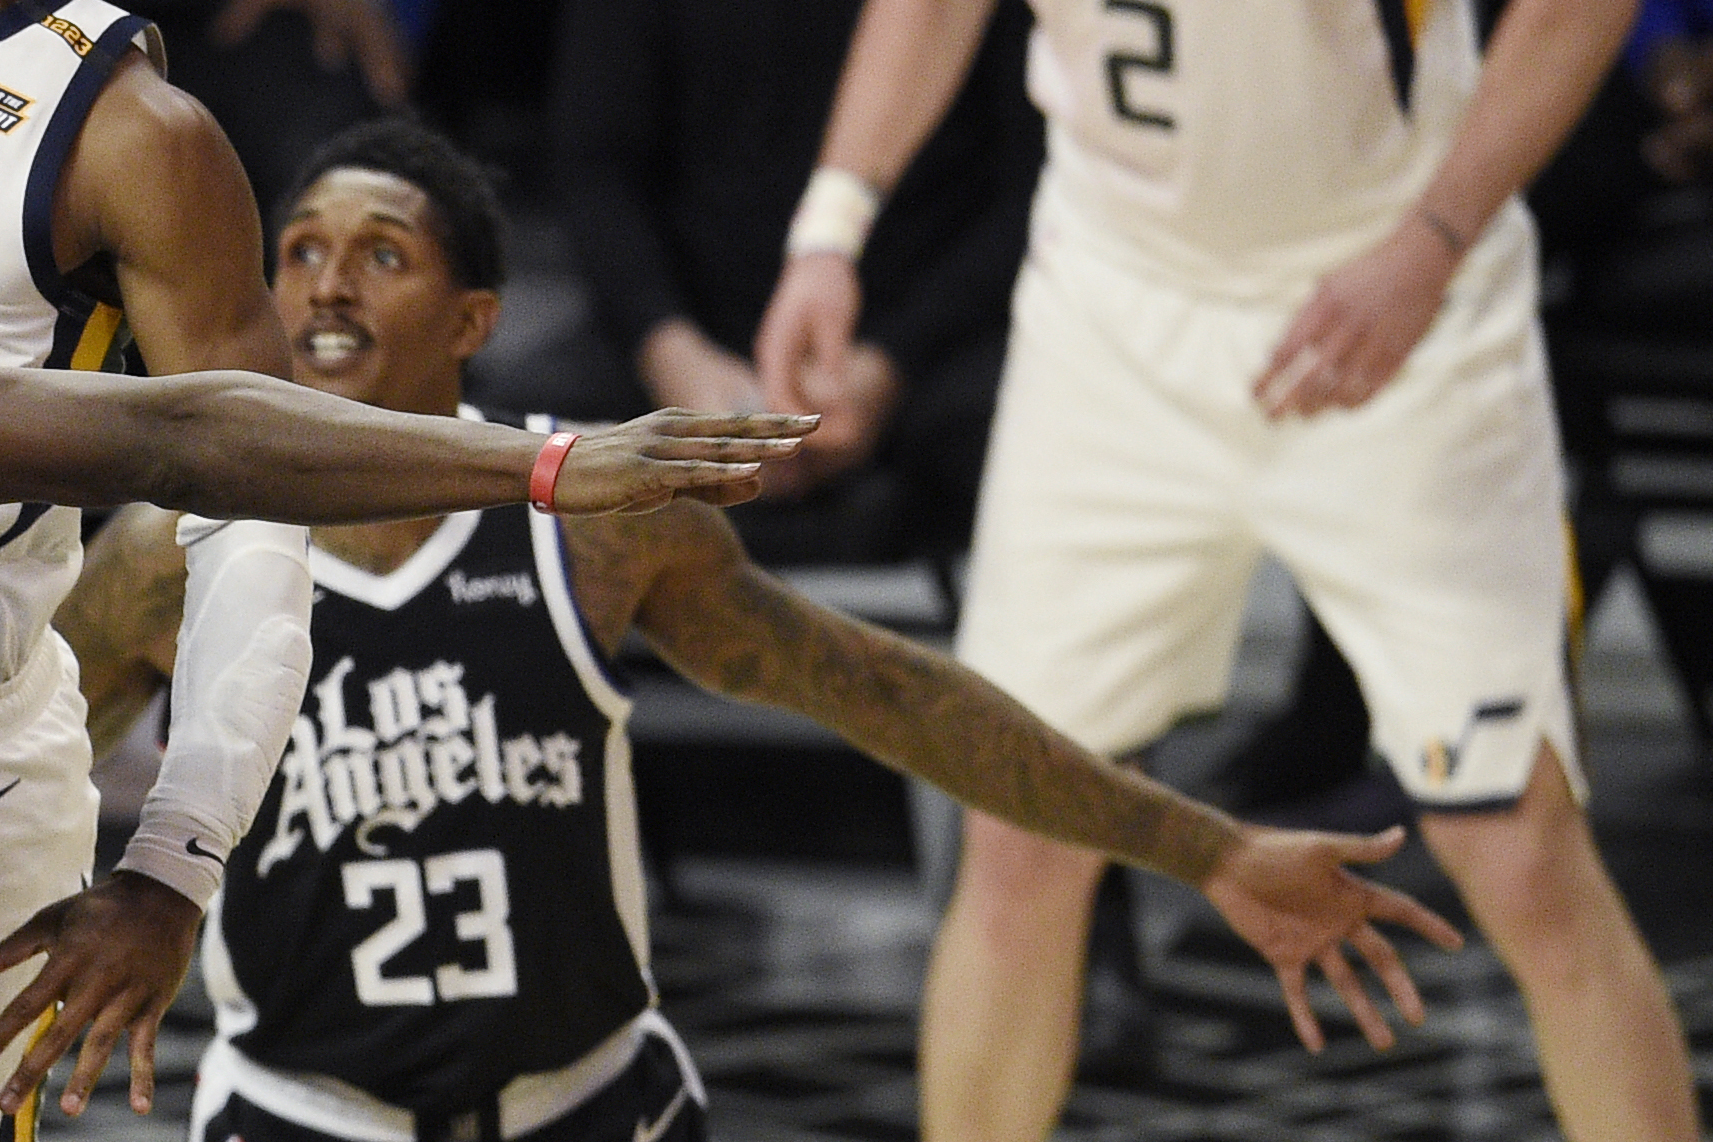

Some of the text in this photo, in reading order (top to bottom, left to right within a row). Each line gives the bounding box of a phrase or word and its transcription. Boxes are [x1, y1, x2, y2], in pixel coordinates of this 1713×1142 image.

[41, 15, 94, 57] 1223
[2, 94, 26, 111] THE
[313, 655, 469, 746] Los
[257, 691, 584, 878] Angeles
[340, 848, 519, 1007] 23
